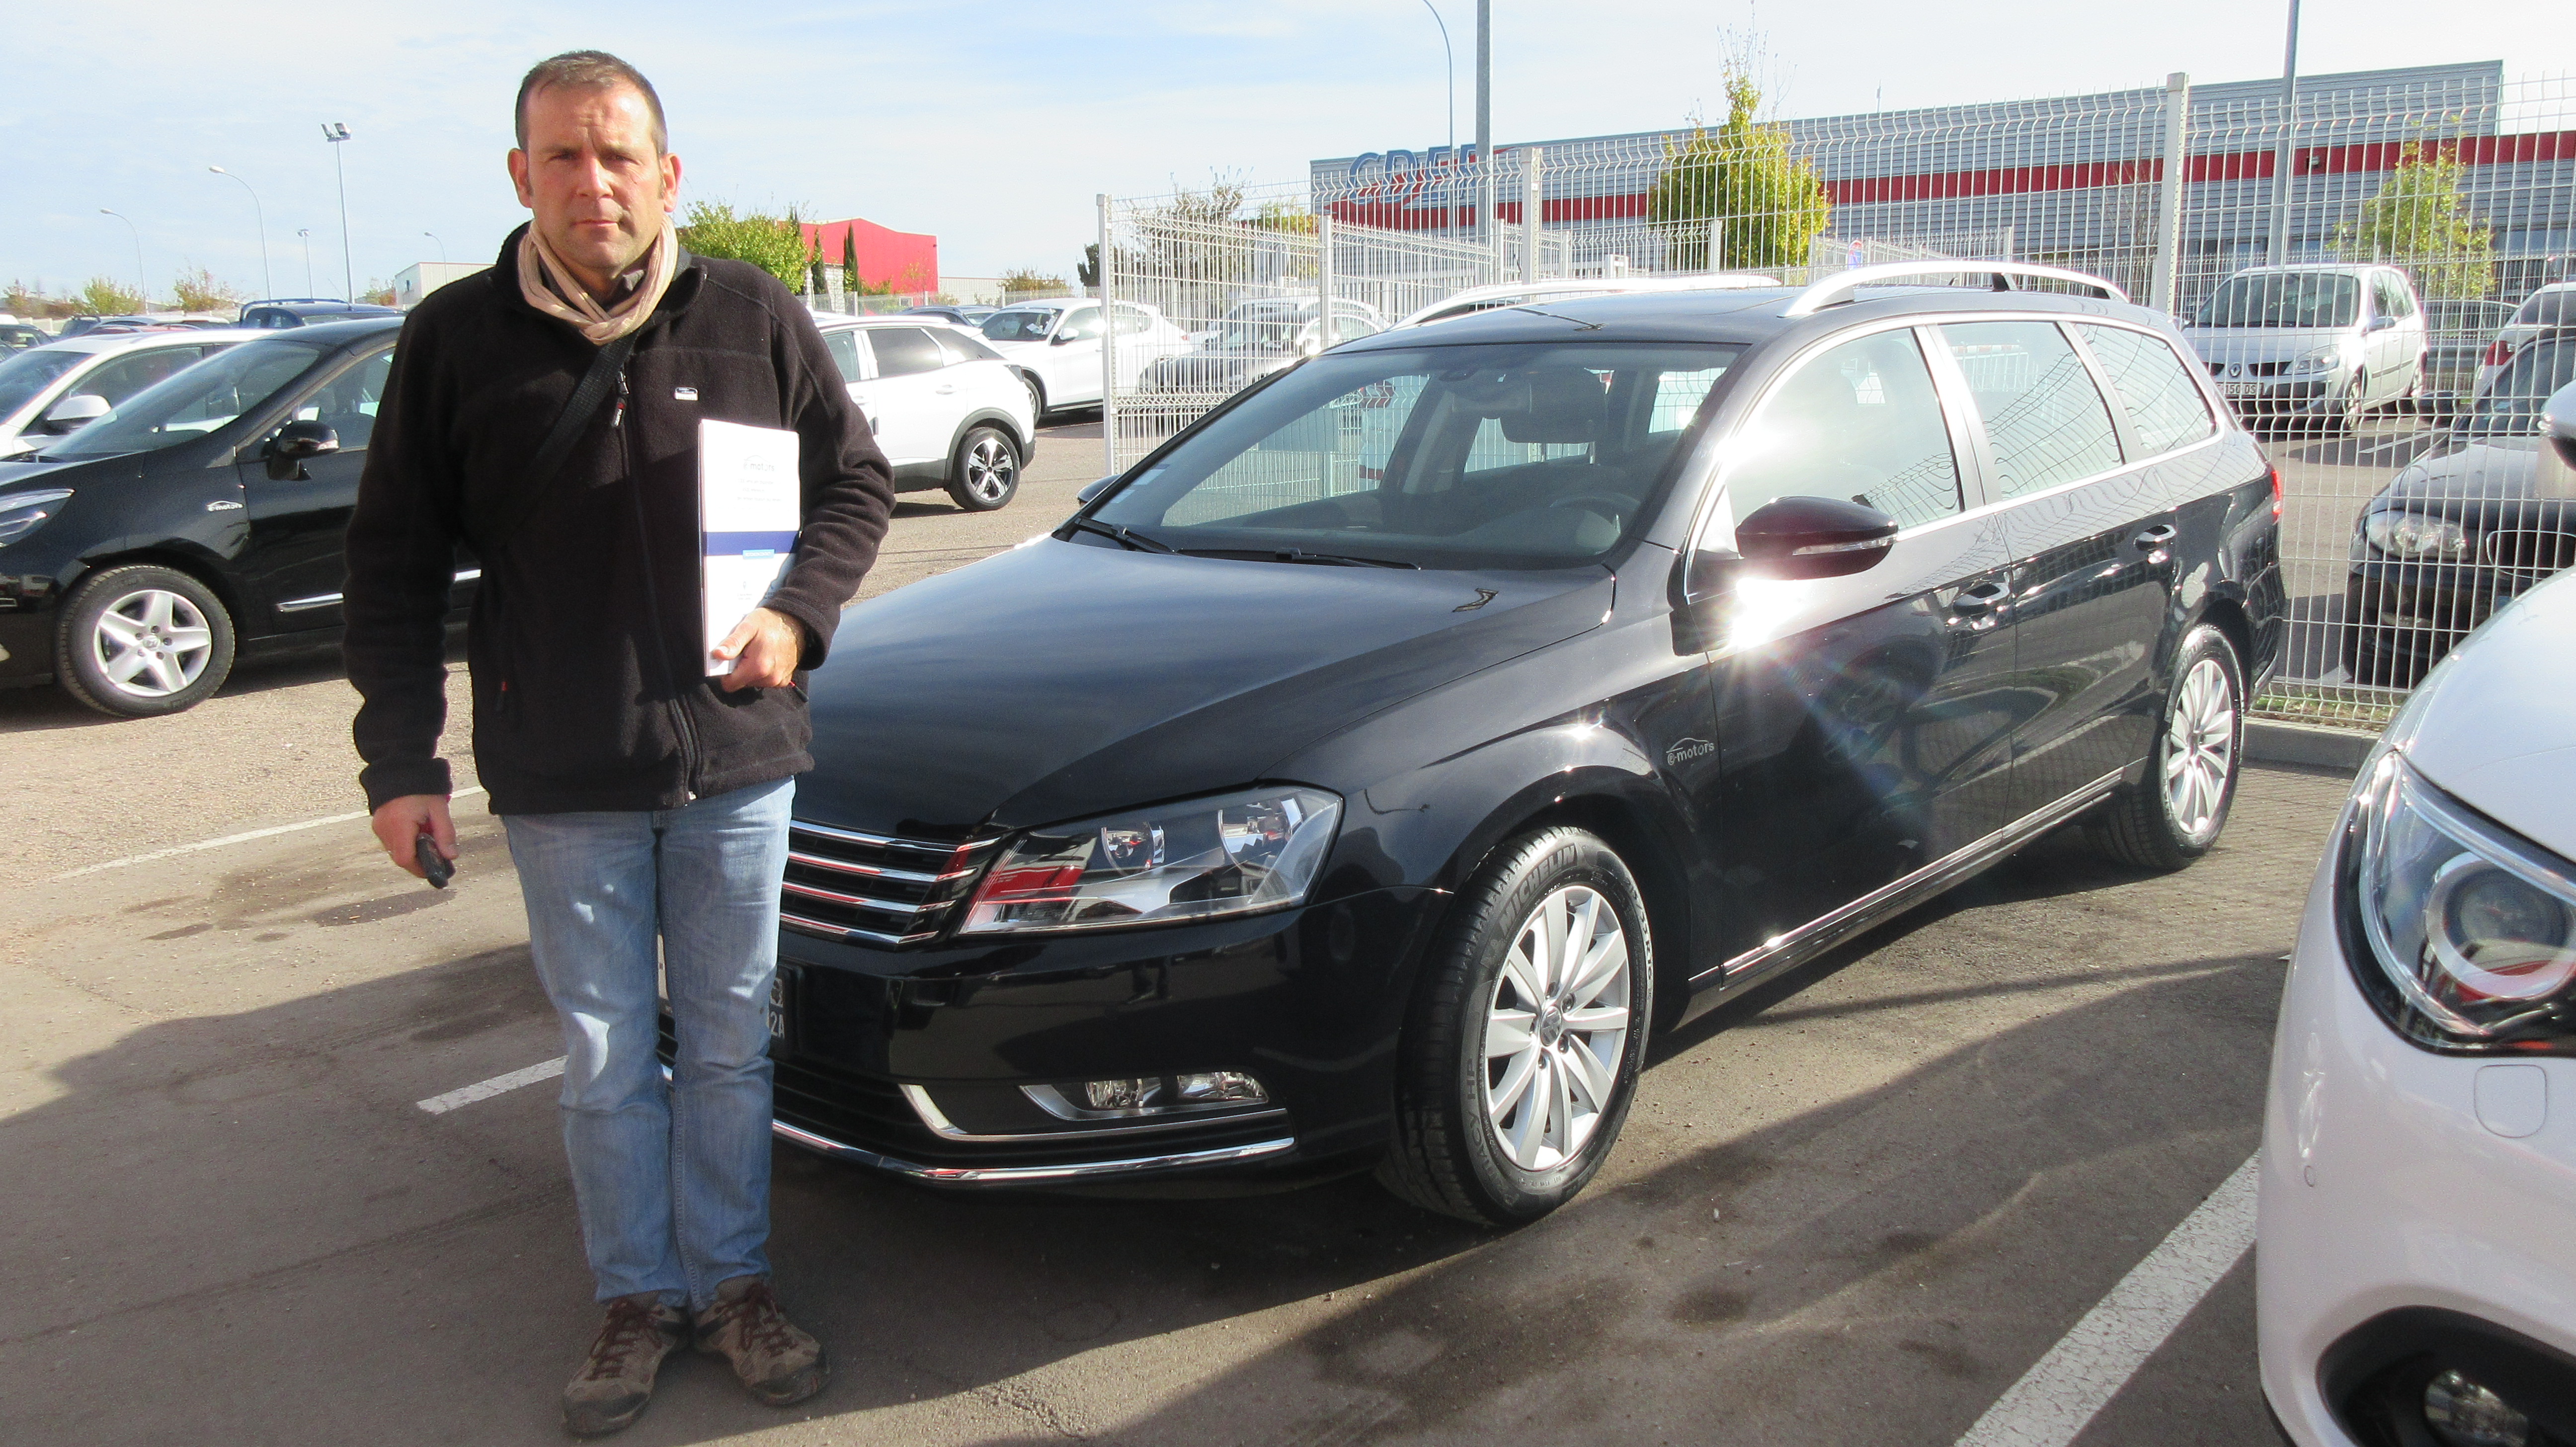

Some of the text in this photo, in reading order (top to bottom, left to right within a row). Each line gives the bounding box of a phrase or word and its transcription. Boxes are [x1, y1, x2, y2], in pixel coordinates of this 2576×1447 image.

[1499, 844, 1577, 936] MICHELIN
[770, 1010, 785, 1039] 2A
[1466, 1058, 1476, 1100] HP
